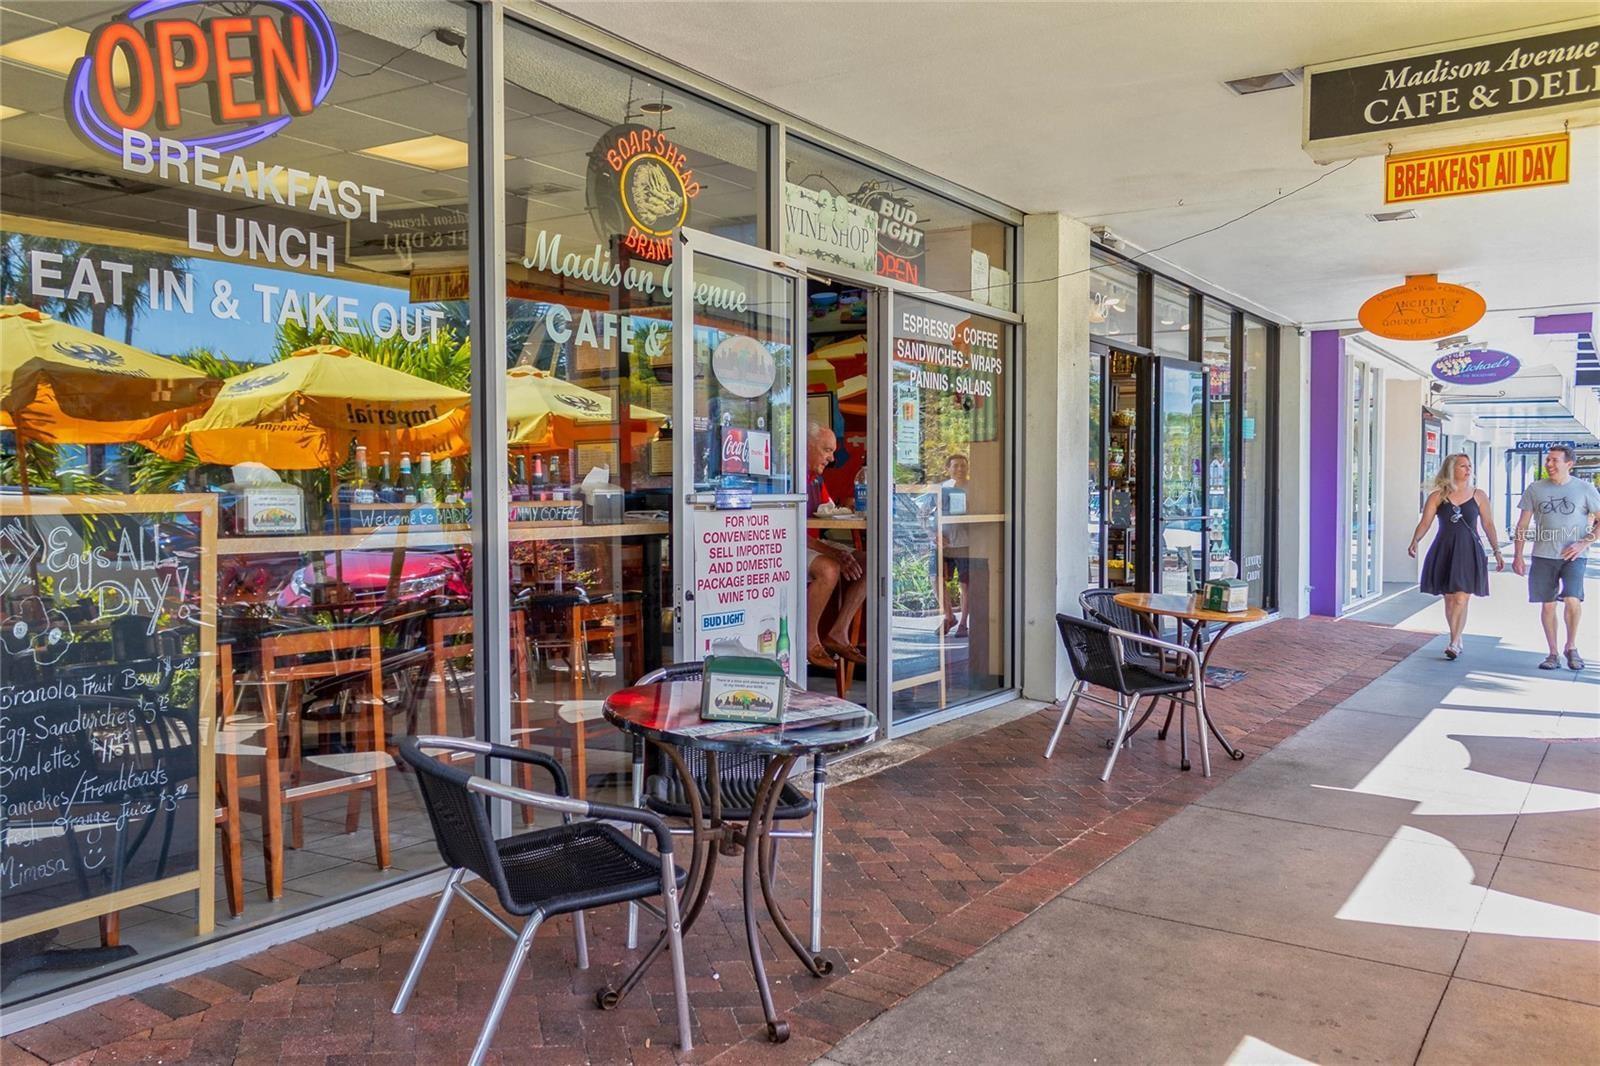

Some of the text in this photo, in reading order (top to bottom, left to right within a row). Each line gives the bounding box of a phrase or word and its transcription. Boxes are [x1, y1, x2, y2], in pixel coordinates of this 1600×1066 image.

[96, 15, 313, 129] OPEN
[1379, 41, 1599, 91] Madison Avenue
[1364, 65, 1600, 125] CAFE & DELI
[122, 128, 384, 223] BREAKFAST
[664, 145, 700, 199] HEAD
[1394, 154, 1490, 198] BREAKFAST
[1522, 145, 1557, 183] DAY
[785, 204, 869, 254] WINE SHOP
[879, 200, 918, 227] BUD
[188, 208, 335, 273] LUNCH
[523, 230, 655, 295] Madison
[31, 250, 133, 305] EAT
[150, 268, 194, 314] IN
[211, 279, 240, 320] &
[254, 284, 358, 335] TAKE
[372, 302, 444, 345] OUT
[546, 303, 668, 357] CAFE &
[902, 313, 998, 349] ESPRESSO COFFEE
[897, 339, 1002, 375] SANDWICHES WRAPS
[910, 370, 992, 397] PANINIS SALADS
[360, 509, 416, 527] Welcome
[419, 511, 434, 525] to
[541, 506, 580, 520] COFFEE
[725, 515, 769, 528] FOR YOUR
[703, 528, 787, 543] CONVENIENCE WE
[709, 543, 782, 559] SELL IMPORTED
[47, 524, 181, 595] Eggs ALL
[708, 557, 782, 574] AND DOMESTIC
[697, 571, 790, 591] PACKAGE BEER AND
[718, 587, 775, 604] WINE TO GO
[703, 612, 744, 628] BUD LIGHT
[0, 681, 79, 709] Granola
[82, 673, 113, 695] Fruit
[116, 800, 155, 831] Juice
[0, 856, 69, 888] Mimosa
